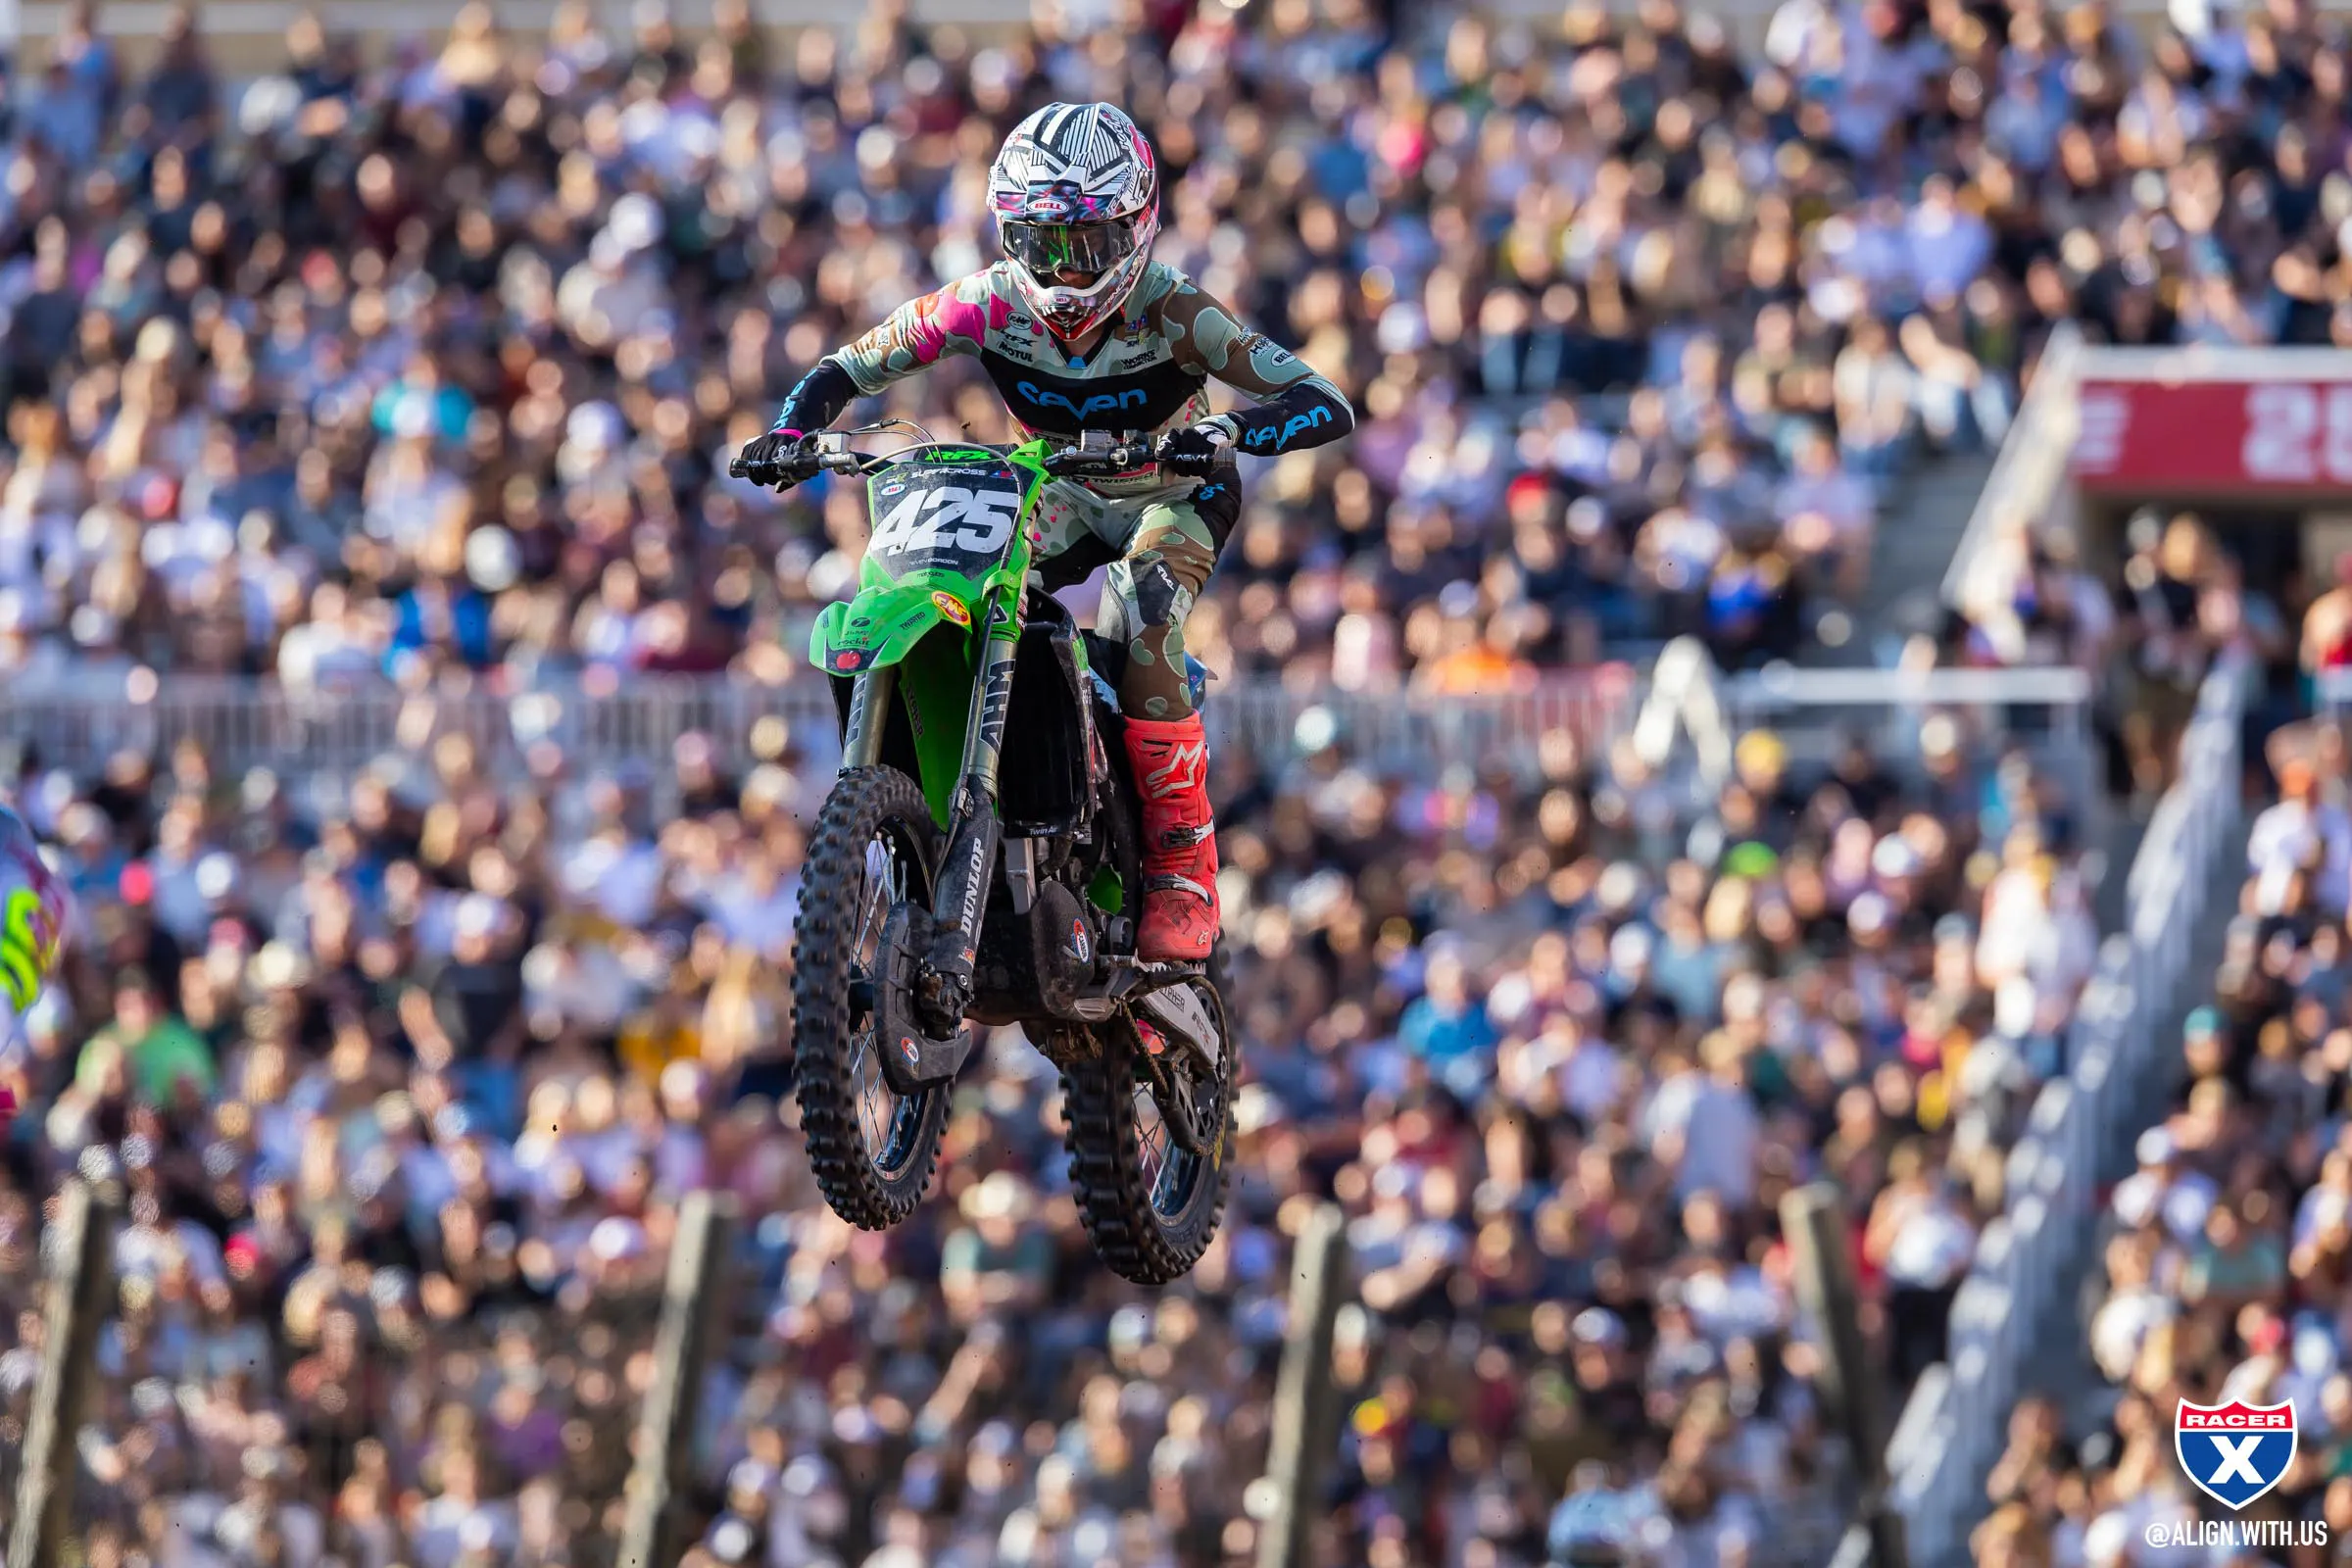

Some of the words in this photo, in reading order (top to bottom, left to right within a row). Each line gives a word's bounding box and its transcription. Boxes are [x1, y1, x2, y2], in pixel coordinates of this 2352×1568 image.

[1034, 202, 1061, 211] BELL
[999, 341, 1034, 363] MOTUL
[910, 466, 987, 479] SUPERCROSS
[869, 486, 1021, 557] 425
[900, 612, 926, 630] TWISTED
[837, 636, 869, 646] rockit
[960, 838, 985, 937] DUNLOP
